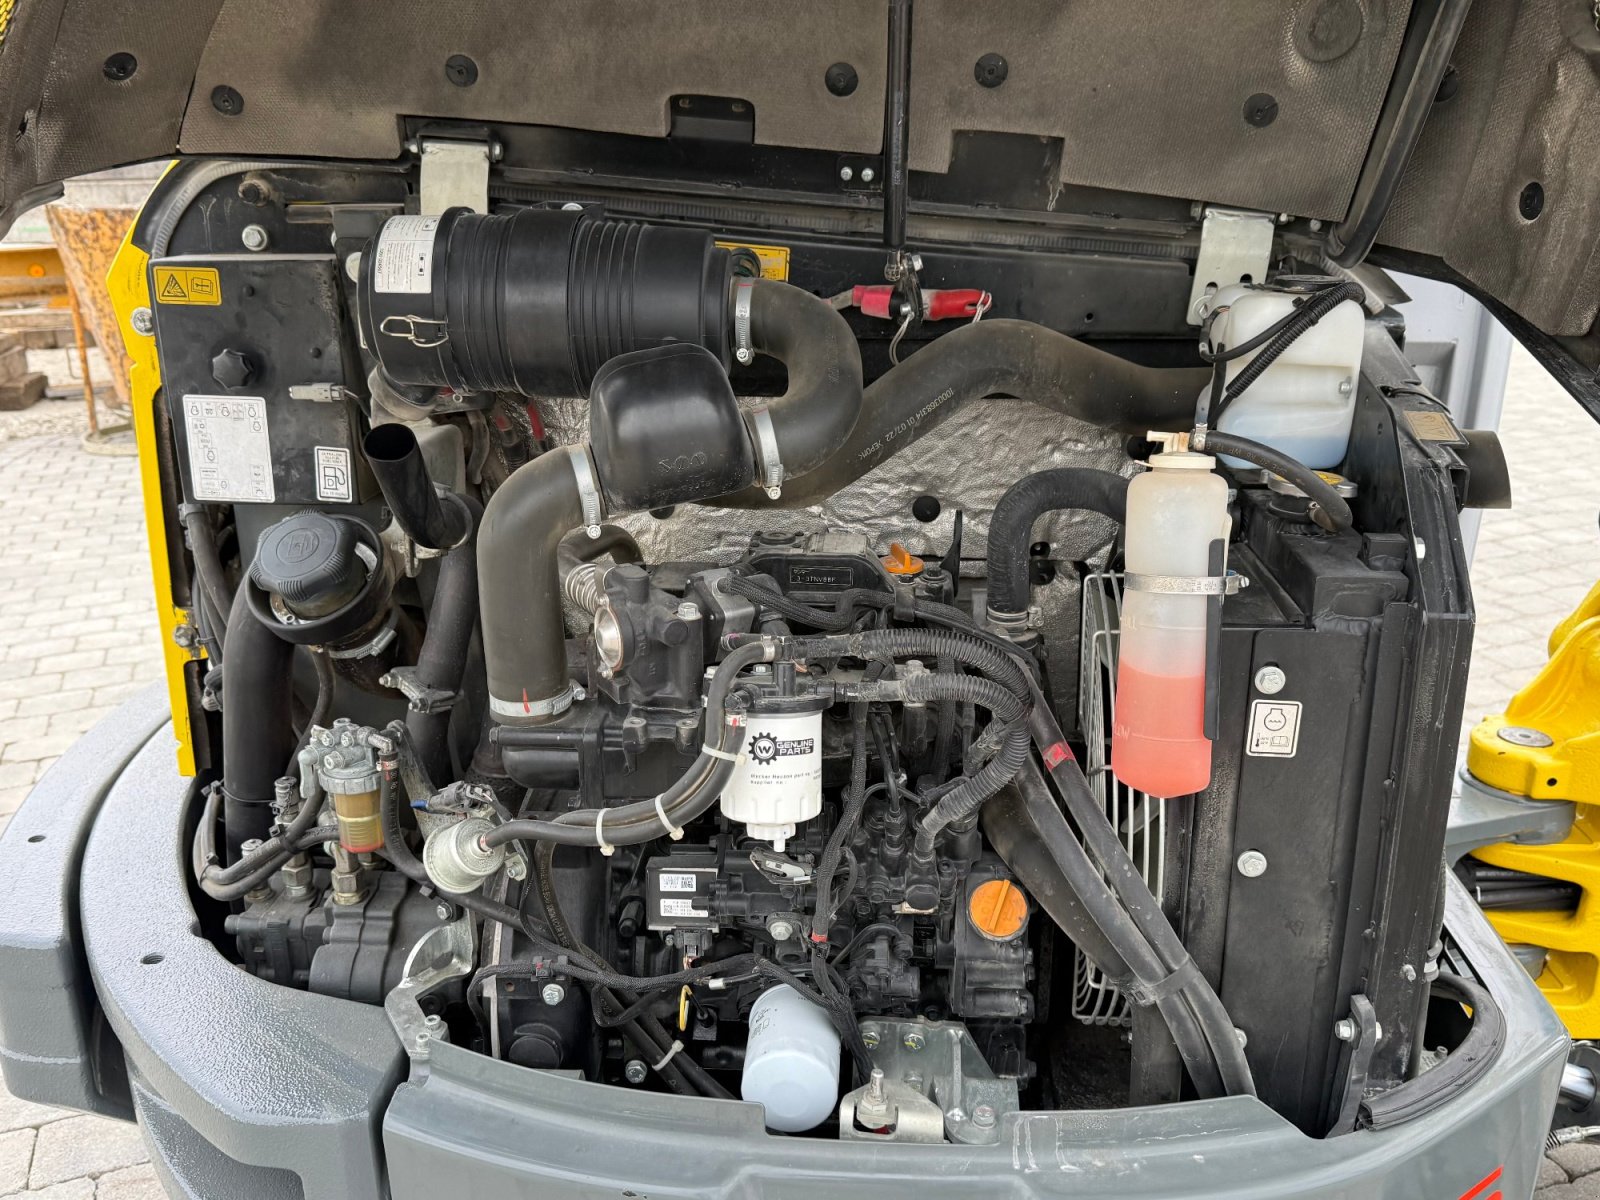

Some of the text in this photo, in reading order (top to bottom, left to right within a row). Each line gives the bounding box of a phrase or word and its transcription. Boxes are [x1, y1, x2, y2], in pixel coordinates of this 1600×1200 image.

[776, 739, 813, 748] GENUINE
[758, 745, 771, 754] W
[780, 747, 811, 755] PARTS
